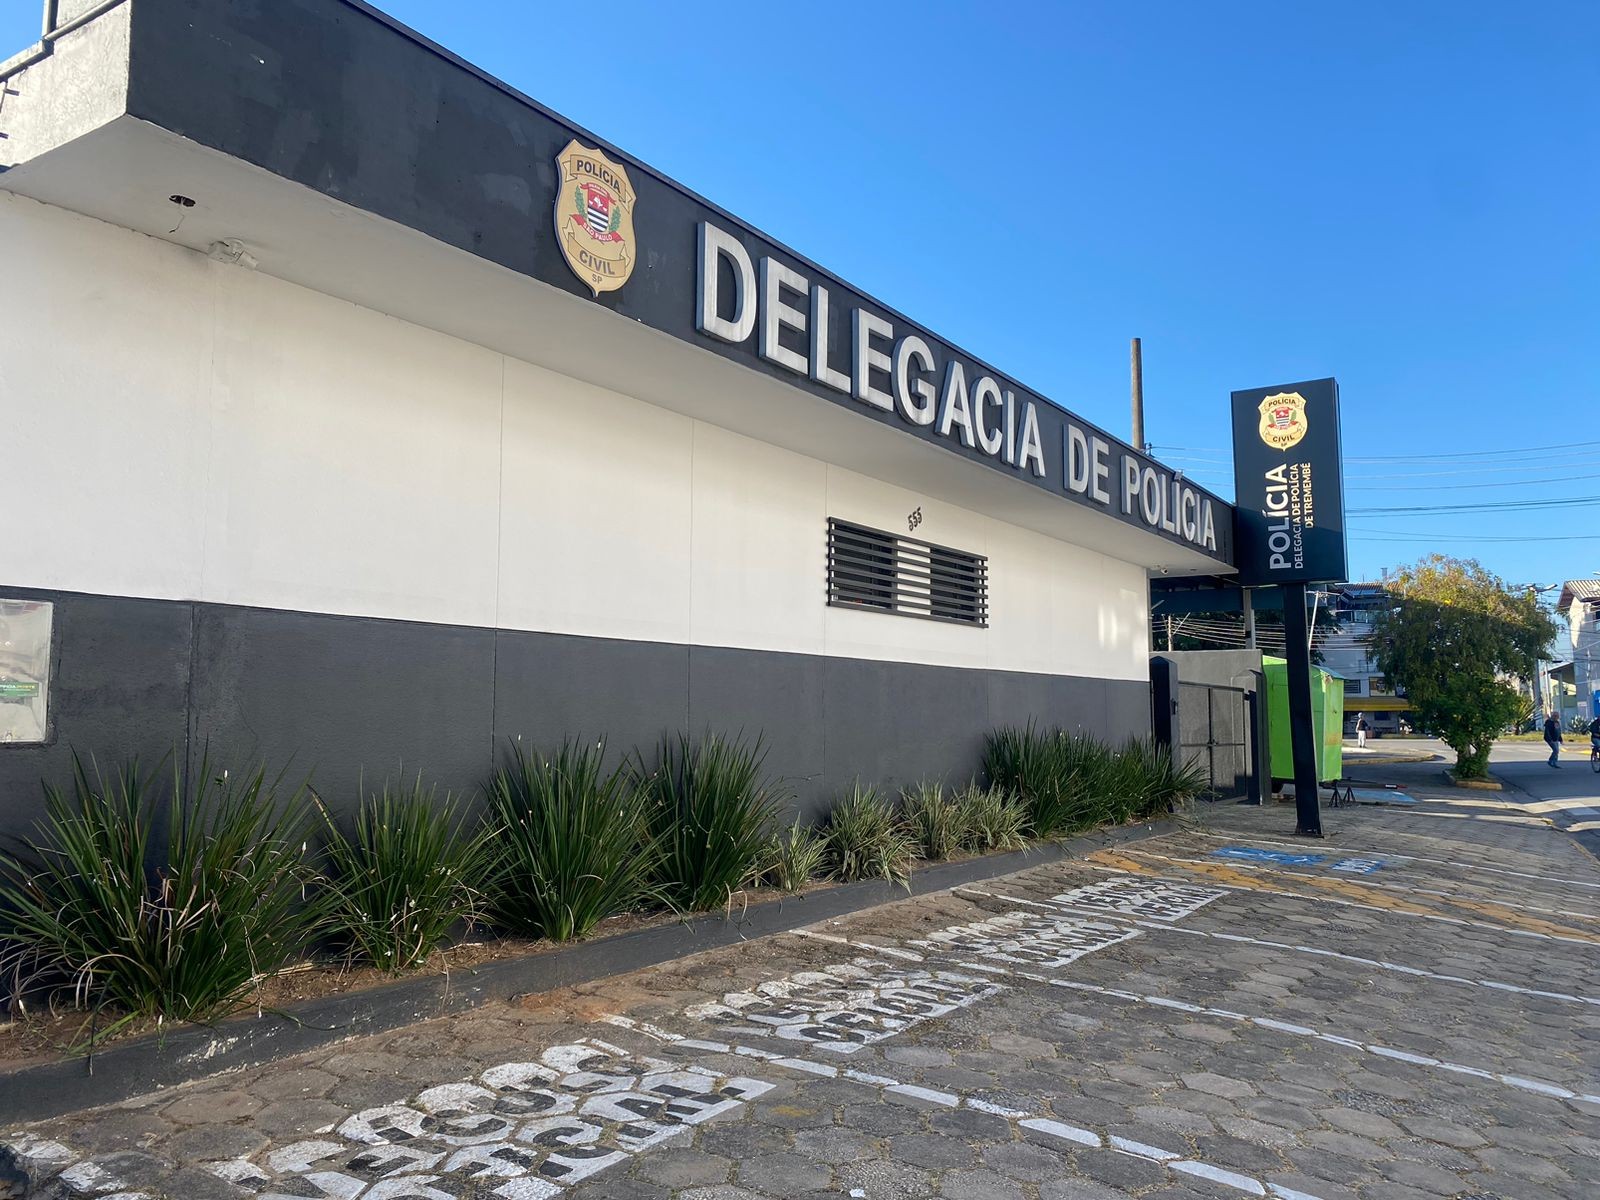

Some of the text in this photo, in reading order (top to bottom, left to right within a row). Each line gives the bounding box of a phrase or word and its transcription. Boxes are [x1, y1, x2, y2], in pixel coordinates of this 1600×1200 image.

[576, 159, 621, 193] POLÍCIA
[579, 250, 615, 275] CIVIL
[591, 273, 603, 285] SP
[698, 221, 1217, 552] DELEGACIA DE POLÍCIA
[1268, 398, 1296, 407] POLÍCIA
[908, 506, 922, 531] 555
[1262, 463, 1292, 570] POLÍCIA
[1289, 463, 1304, 569] DELEGACIA DE POLÍCIA
[1301, 462, 1314, 528] DE TREMEMBÉ
[386, 1086, 748, 1200] FICIAL
